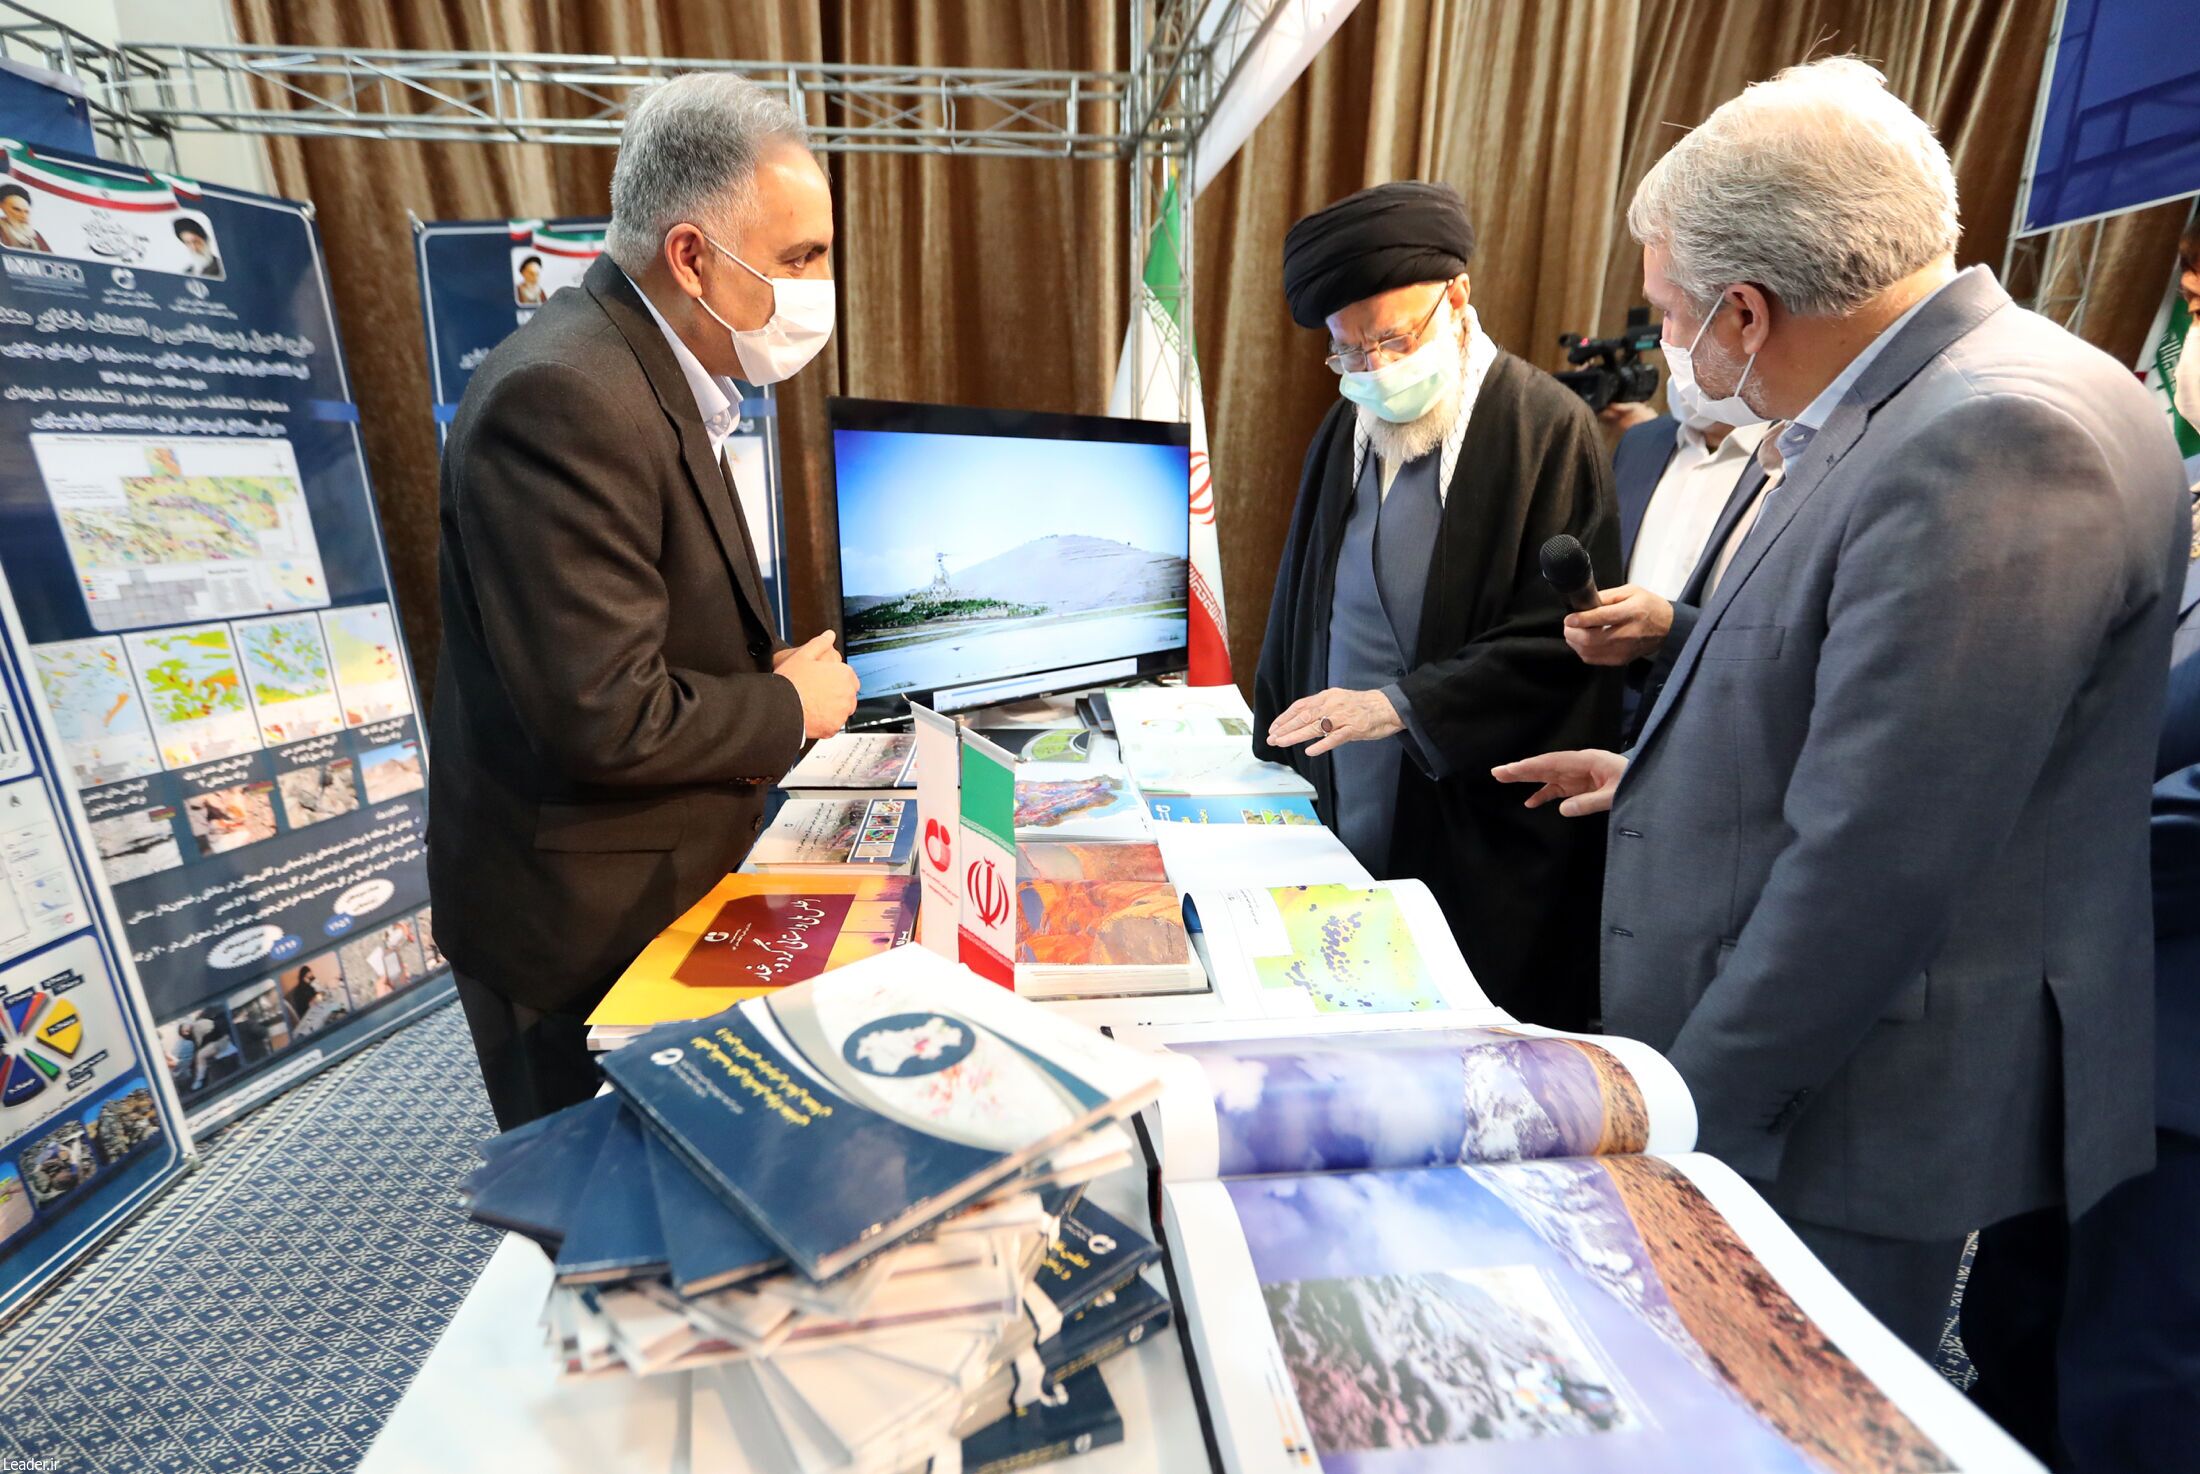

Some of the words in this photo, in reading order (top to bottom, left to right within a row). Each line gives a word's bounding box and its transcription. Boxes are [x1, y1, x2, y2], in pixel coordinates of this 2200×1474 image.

[790, 898, 825, 918] اطلس
[787, 915, 820, 925] ملی
[776, 927, 808, 950] استانی
[752, 938, 794, 962] گرد
[746, 963, 783, 982] غبار
